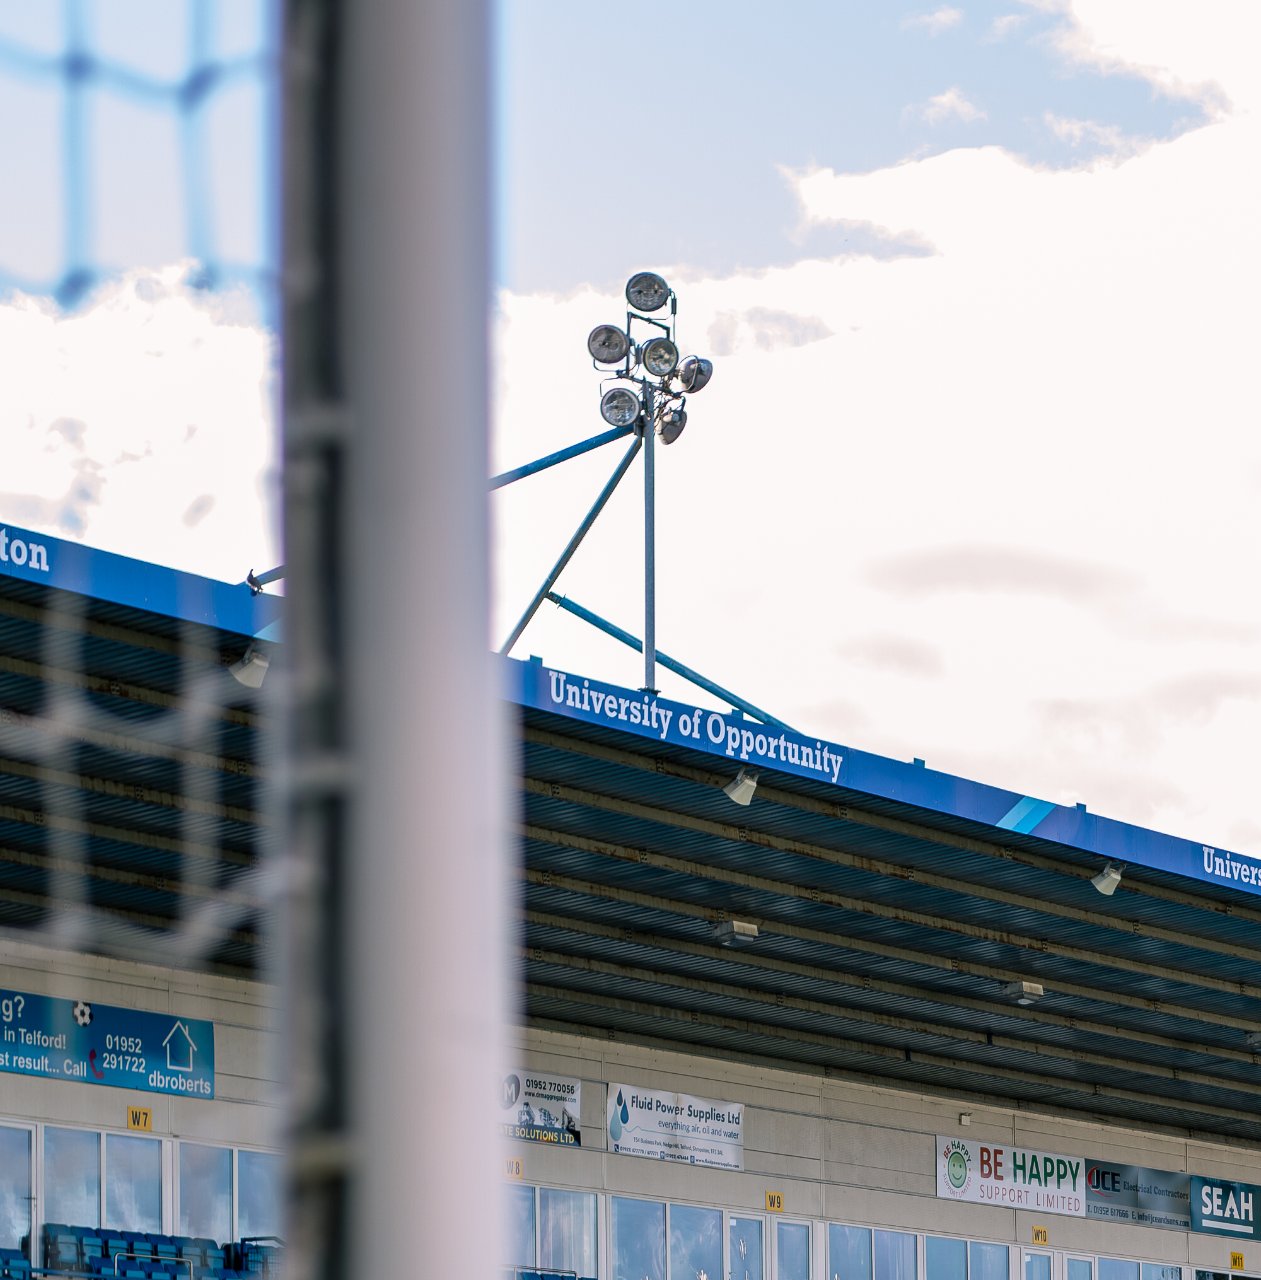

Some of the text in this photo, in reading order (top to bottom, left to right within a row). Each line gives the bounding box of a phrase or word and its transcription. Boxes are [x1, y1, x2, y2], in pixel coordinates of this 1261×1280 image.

[549, 671, 843, 783] University of Opportunity
[4, 1026, 67, 1050] in Telford!
[106, 1034, 142, 1054] 01952
[13, 1057, 60, 1074] result...
[63, 1058, 87, 1078] Call
[102, 1053, 146, 1074] 291722
[148, 1070, 212, 1095] dbroberts
[525, 1079, 575, 1095] 01952 770056
[631, 1095, 741, 1125] Fluid Power Supplies Ltd
[515, 1127, 559, 1142] SOLUTIONS
[560, 1134, 575, 1144] LTD
[658, 1120, 690, 1134] everything
[711, 1126, 722, 1137] and
[722, 1129, 739, 1140] water
[951, 1140, 972, 1163] HAPPY
[979, 1146, 1081, 1192] BE HAPPY
[1092, 1169, 1121, 1192] JCE
[979, 1184, 1081, 1212] SUPPORT LIMITED
[1124, 1181, 1189, 1200] Electrical Contractors
[1201, 1185, 1254, 1221] SEAH
[1034, 1228, 1047, 1243] W10
